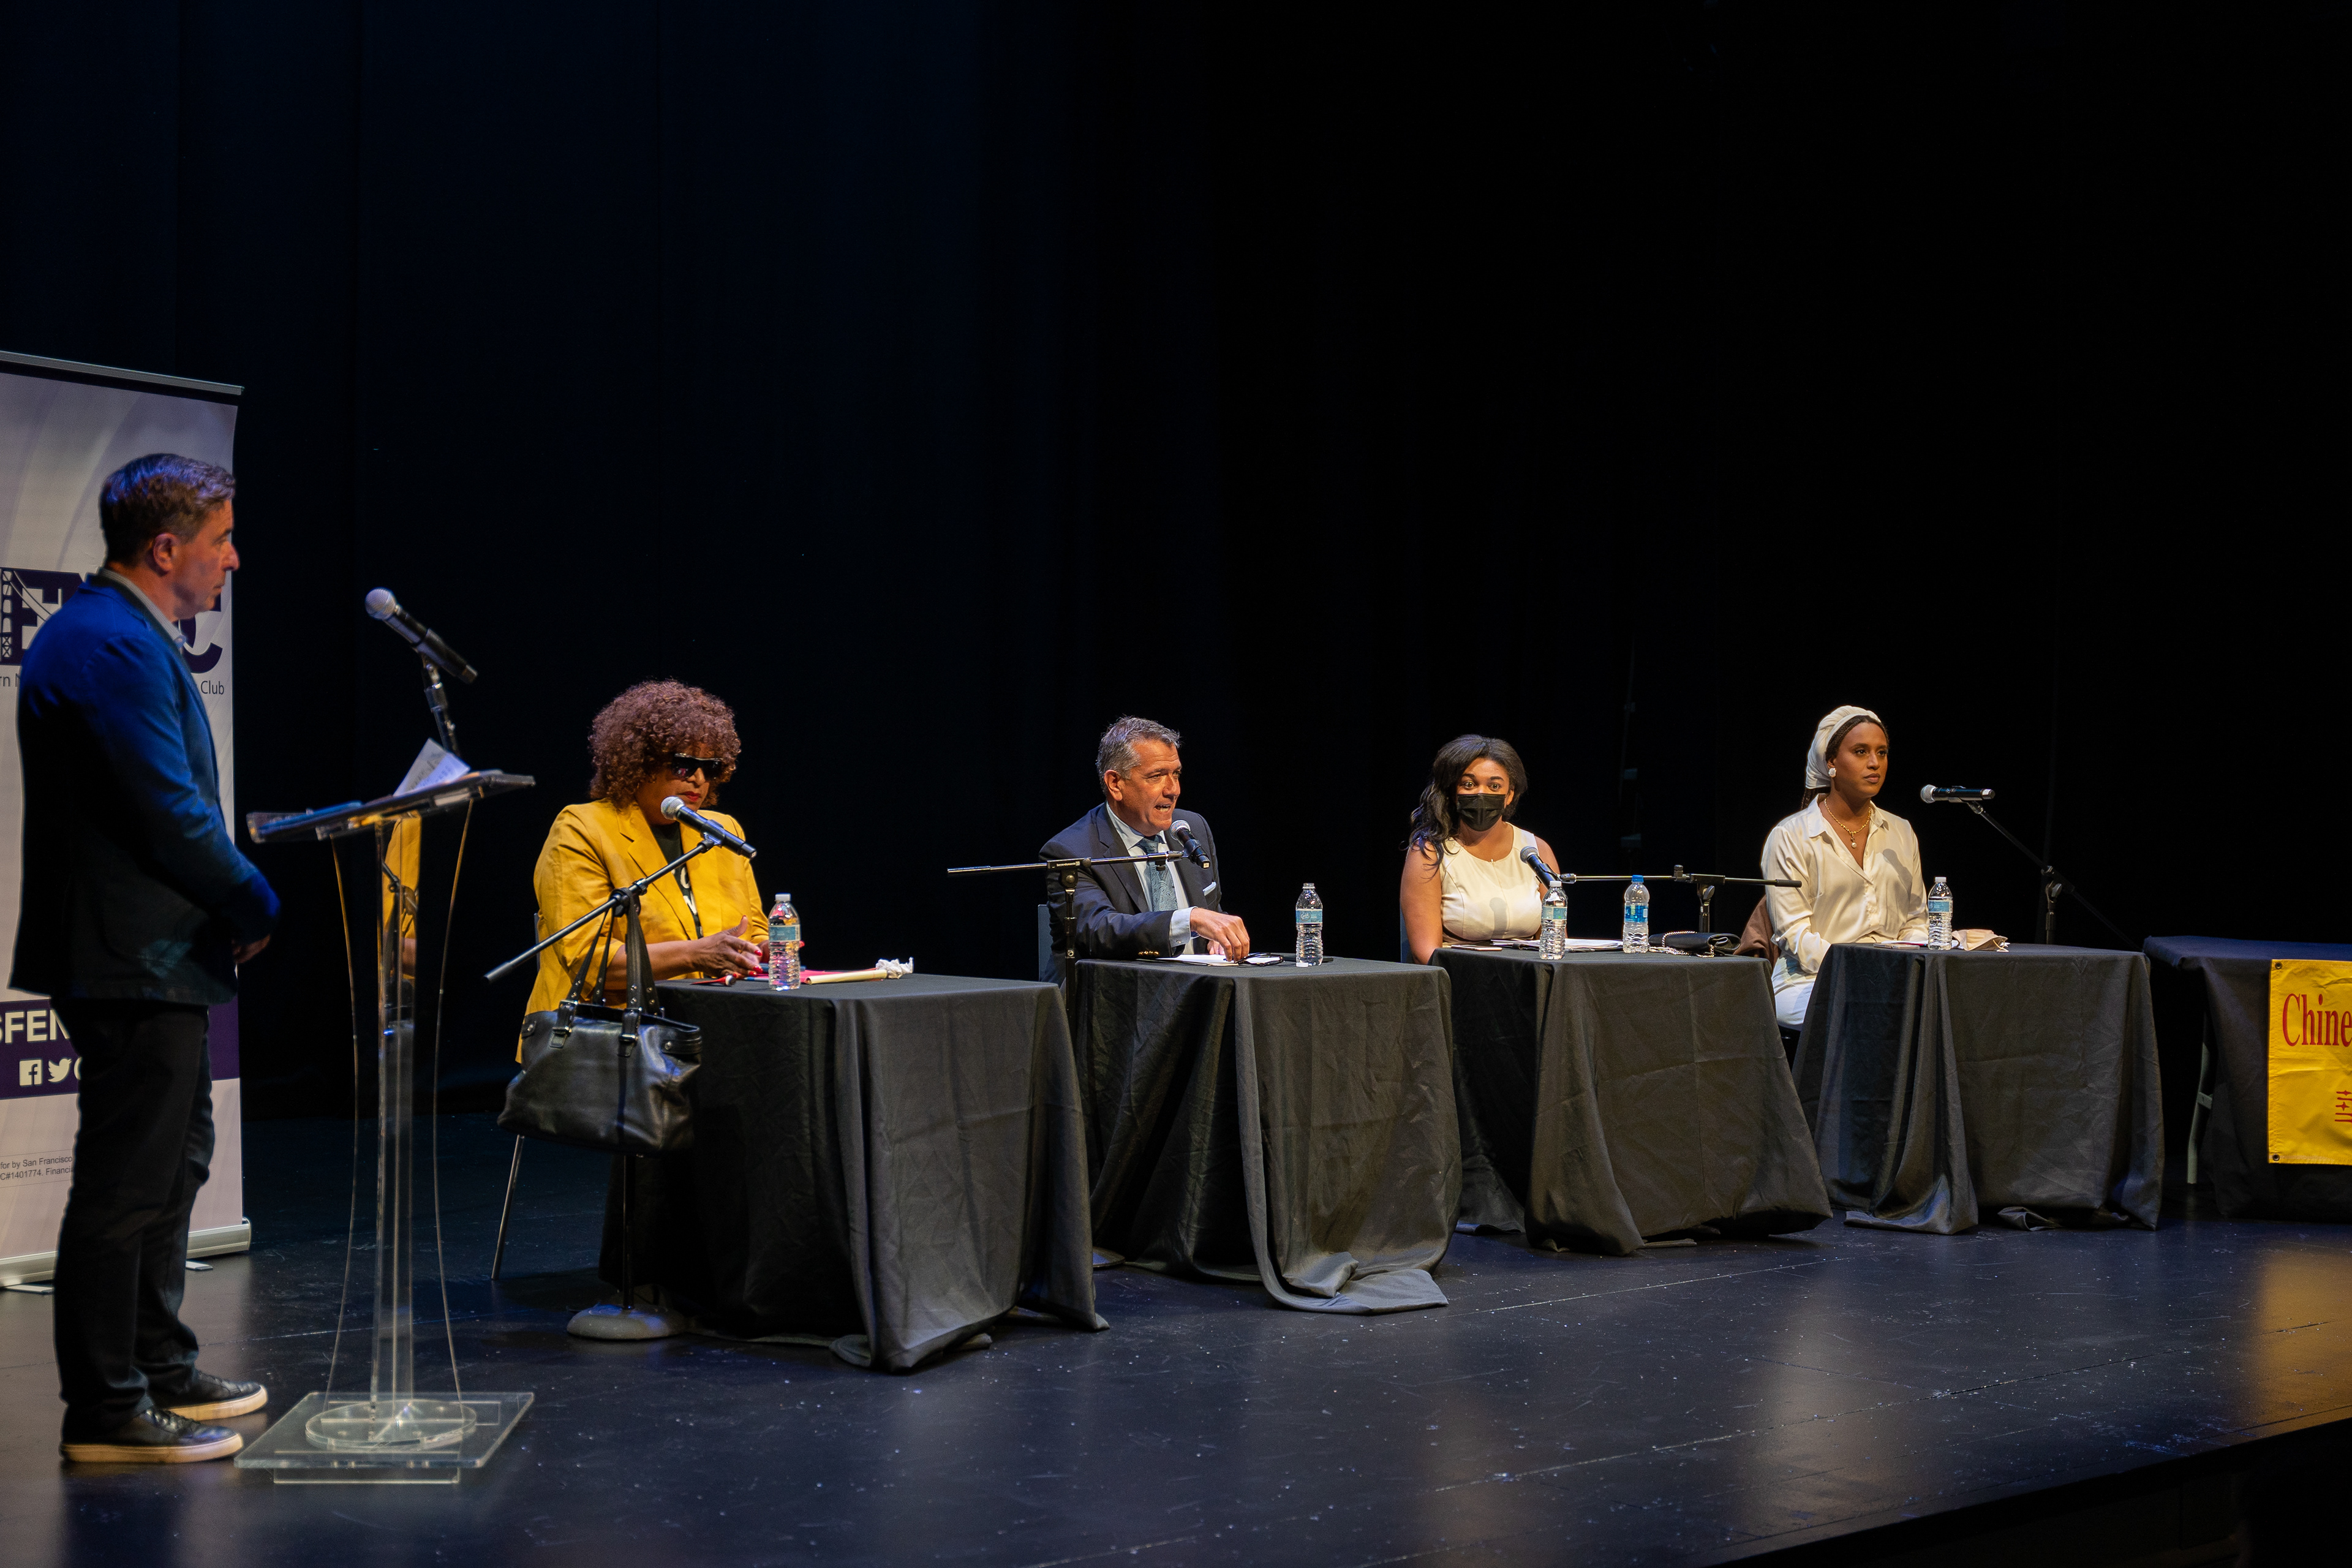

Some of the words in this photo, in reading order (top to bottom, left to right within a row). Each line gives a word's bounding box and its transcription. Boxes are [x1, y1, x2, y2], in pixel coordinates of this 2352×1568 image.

[200, 680, 224, 695] Club
[0, 1009, 70, 1044] FEN
[2282, 993, 2352, 1047] Chine
[12, 1161, 20, 1170] by
[23, 1159, 37, 1167] San
[39, 1156, 72, 1166] Francisco
[0, 1169, 43, 1180] C#1401774.
